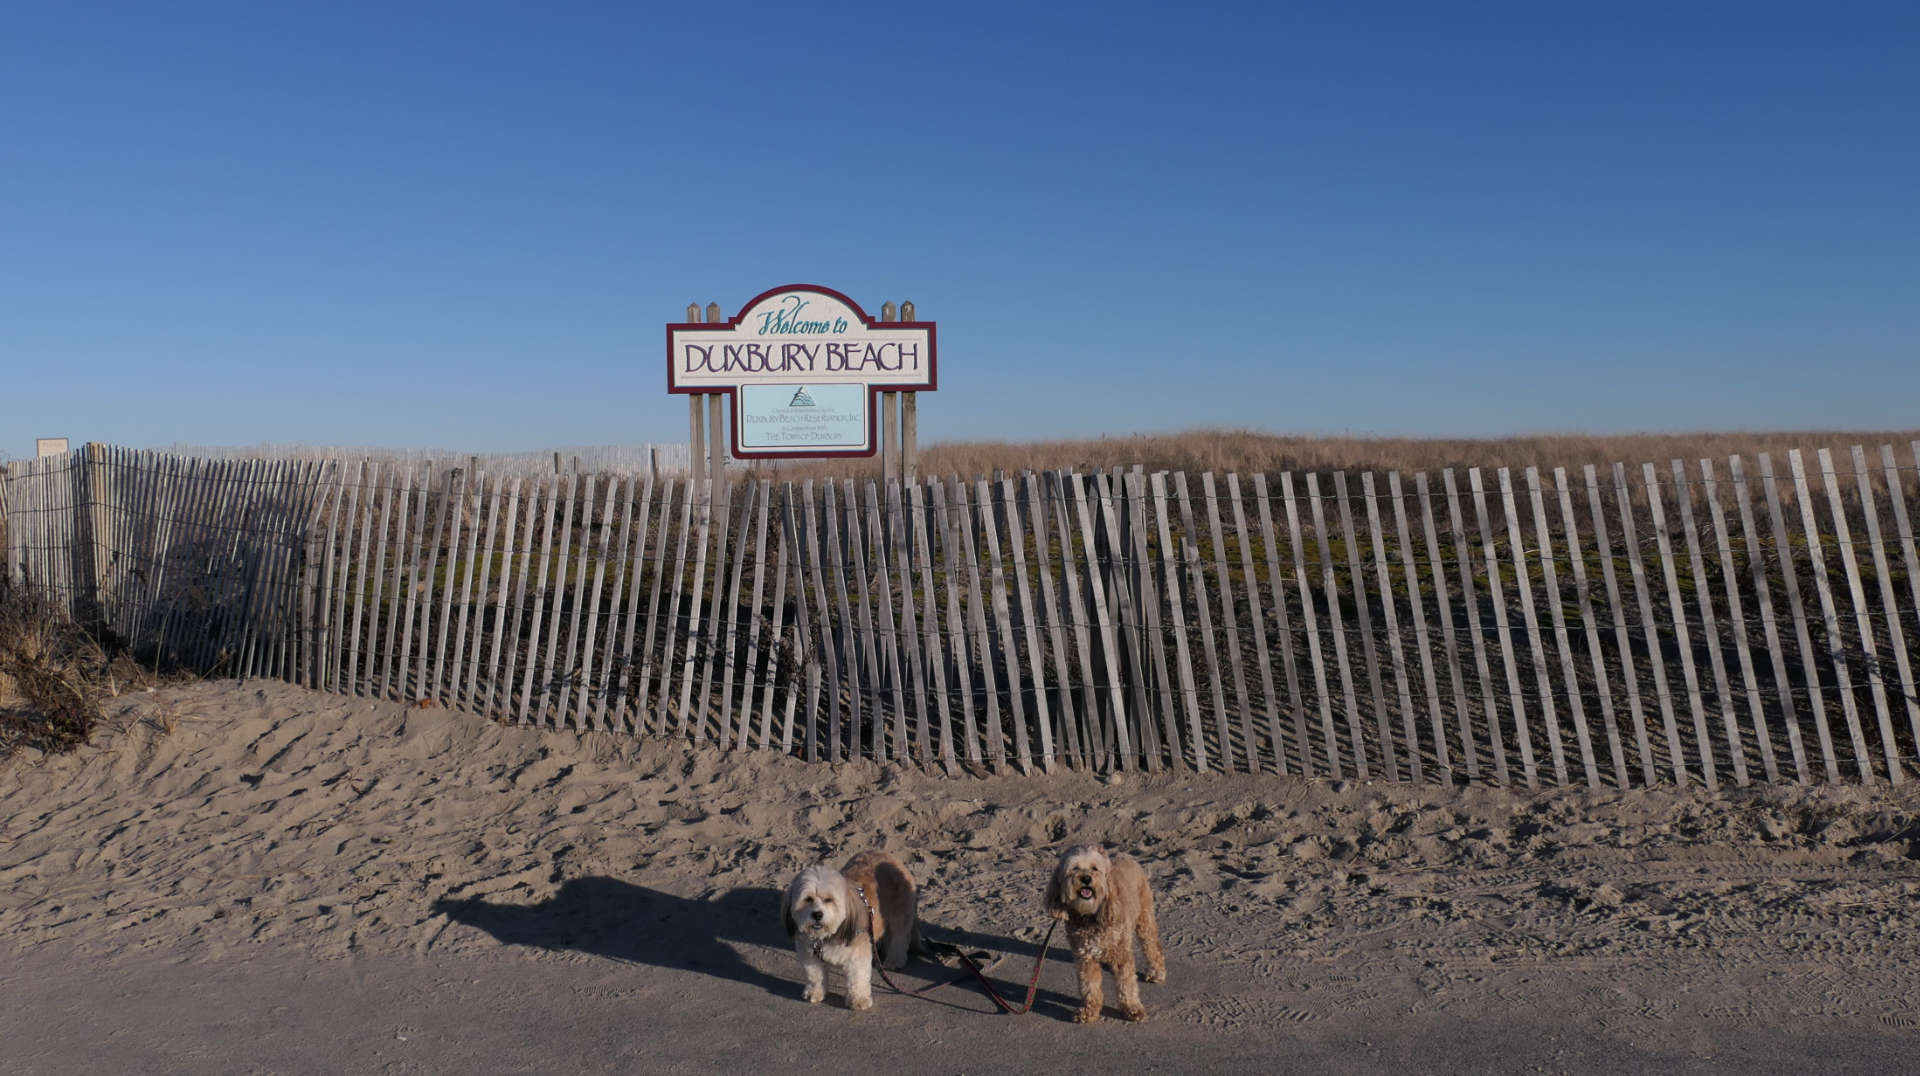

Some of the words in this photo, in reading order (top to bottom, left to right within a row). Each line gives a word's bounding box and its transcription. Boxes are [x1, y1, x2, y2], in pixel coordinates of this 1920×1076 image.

[757, 296, 830, 335] Welcome
[832, 316, 848, 334] to
[685, 343, 821, 373] DUXBURY
[825, 342, 919, 372] BEACH
